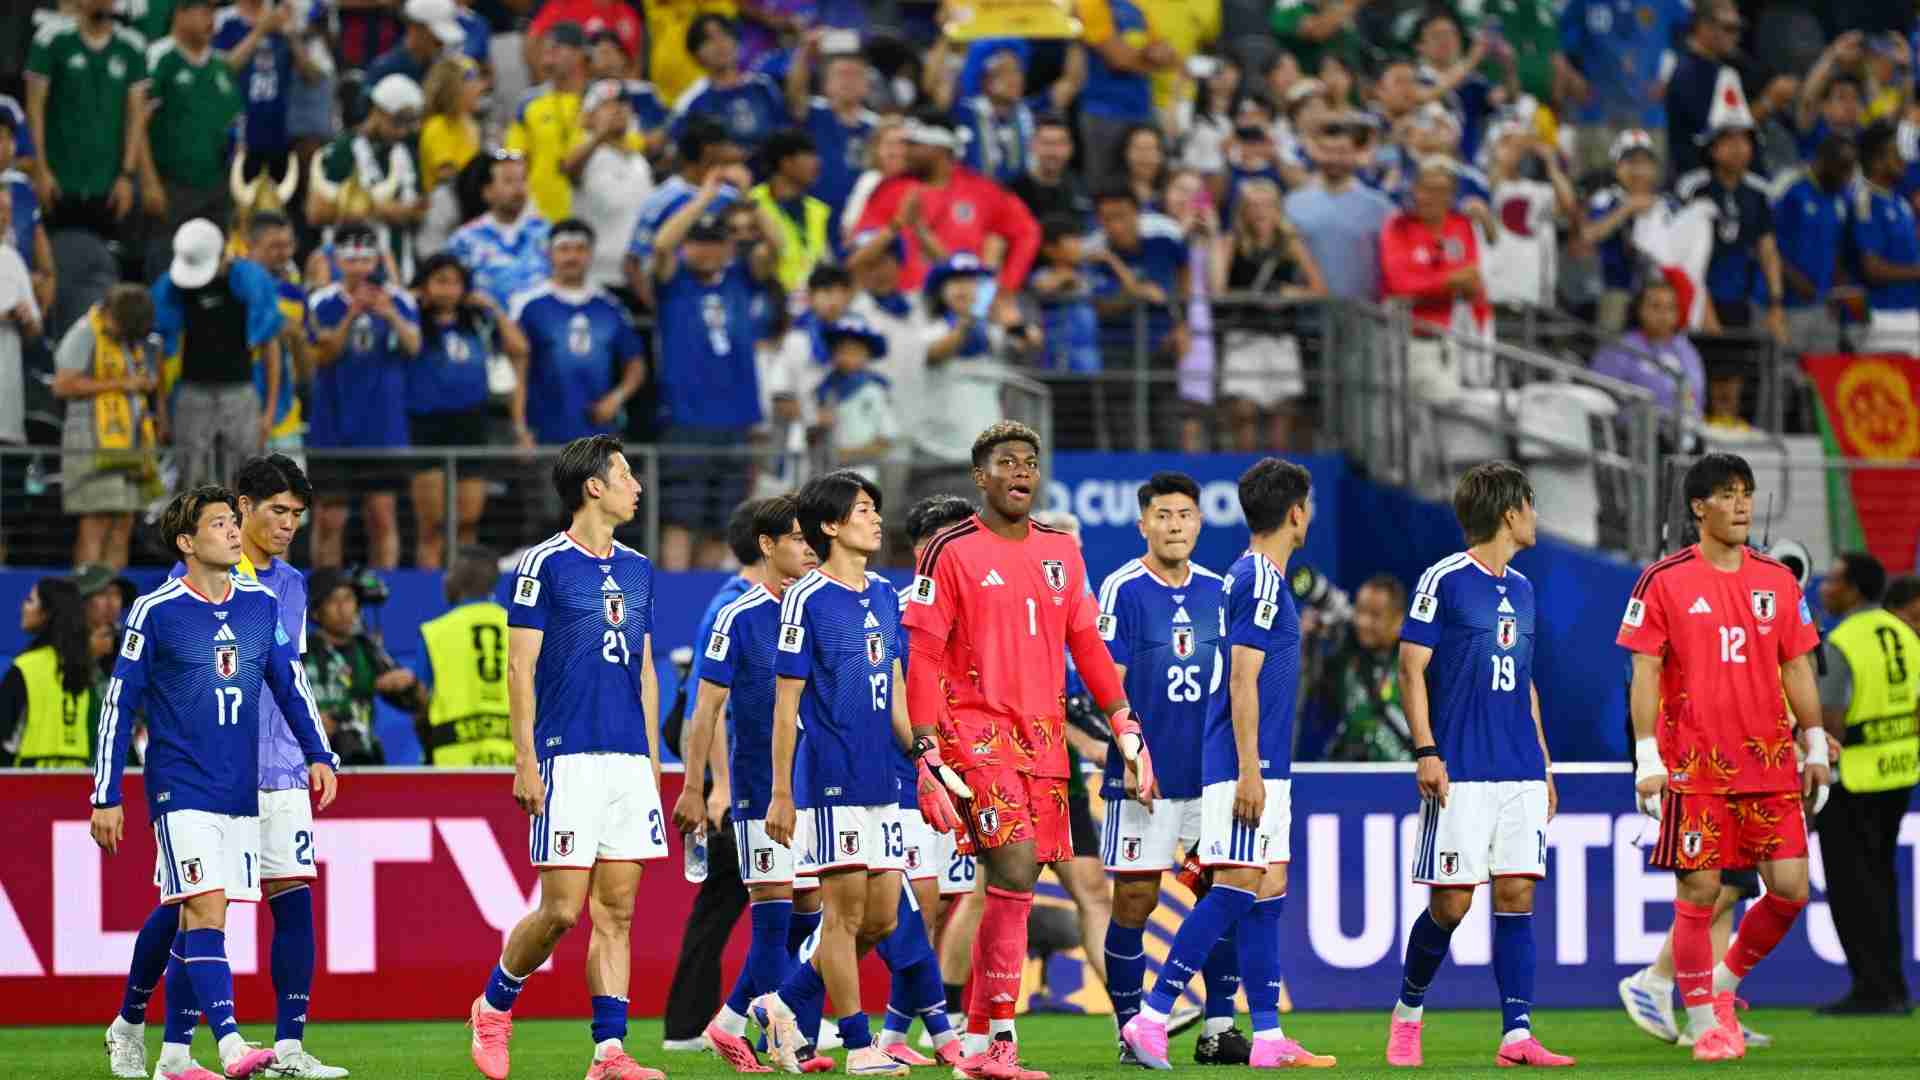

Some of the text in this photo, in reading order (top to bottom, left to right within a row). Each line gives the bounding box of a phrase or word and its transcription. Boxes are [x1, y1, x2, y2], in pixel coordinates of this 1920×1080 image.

[1073, 480, 1140, 527] CU
[1025, 597, 1037, 636] 1
[602, 629, 630, 666] 21
[1719, 625, 1747, 664] 12
[868, 672, 888, 711] 13
[1167, 665, 1201, 702] 25
[1491, 655, 1516, 692] 19
[214, 686, 243, 726] 17
[882, 821, 904, 858] 13
[948, 850, 977, 882] 26
